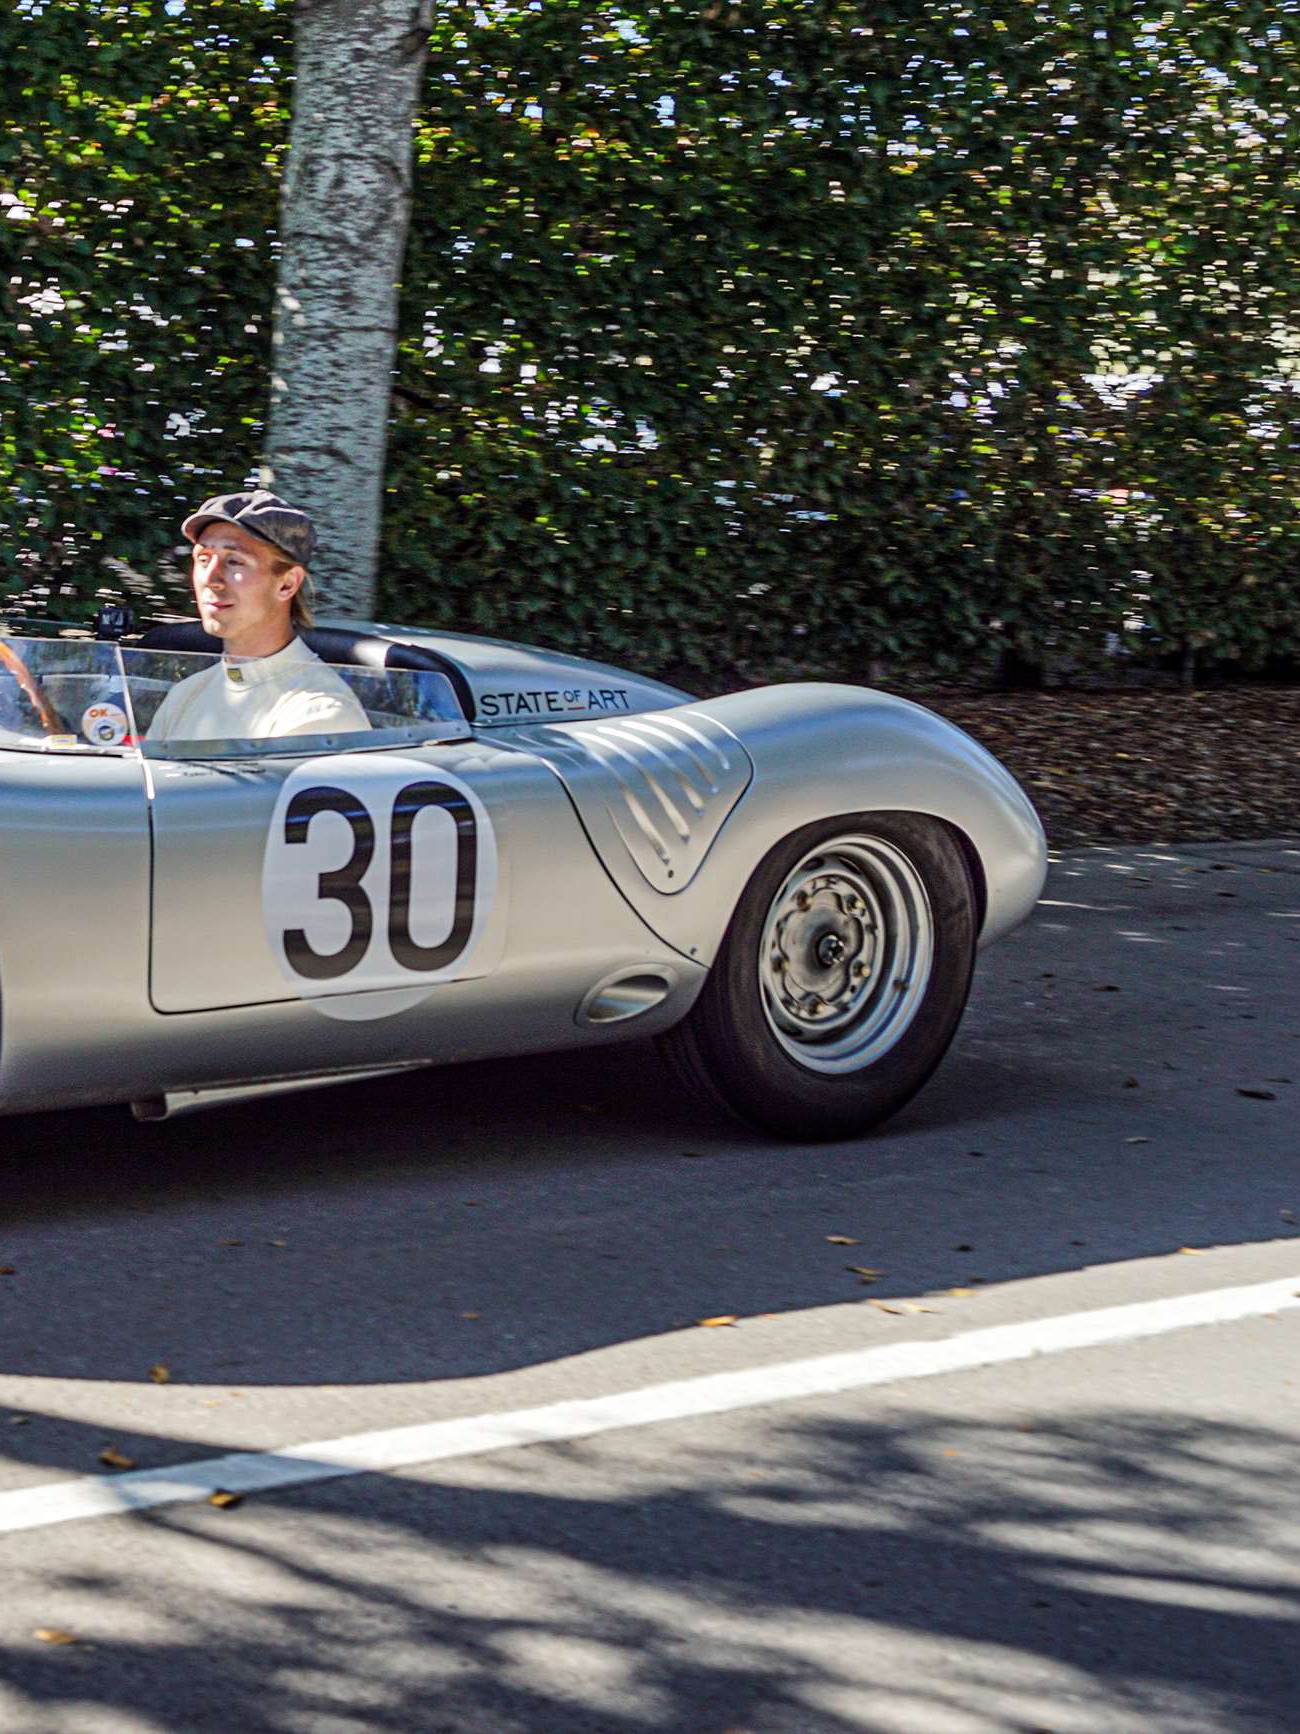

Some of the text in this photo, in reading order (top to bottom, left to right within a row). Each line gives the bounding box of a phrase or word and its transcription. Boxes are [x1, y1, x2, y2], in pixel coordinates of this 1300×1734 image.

[89, 708, 109, 718] OK
[480, 690, 630, 716] STATE OF ART
[283, 781, 478, 980] 30
